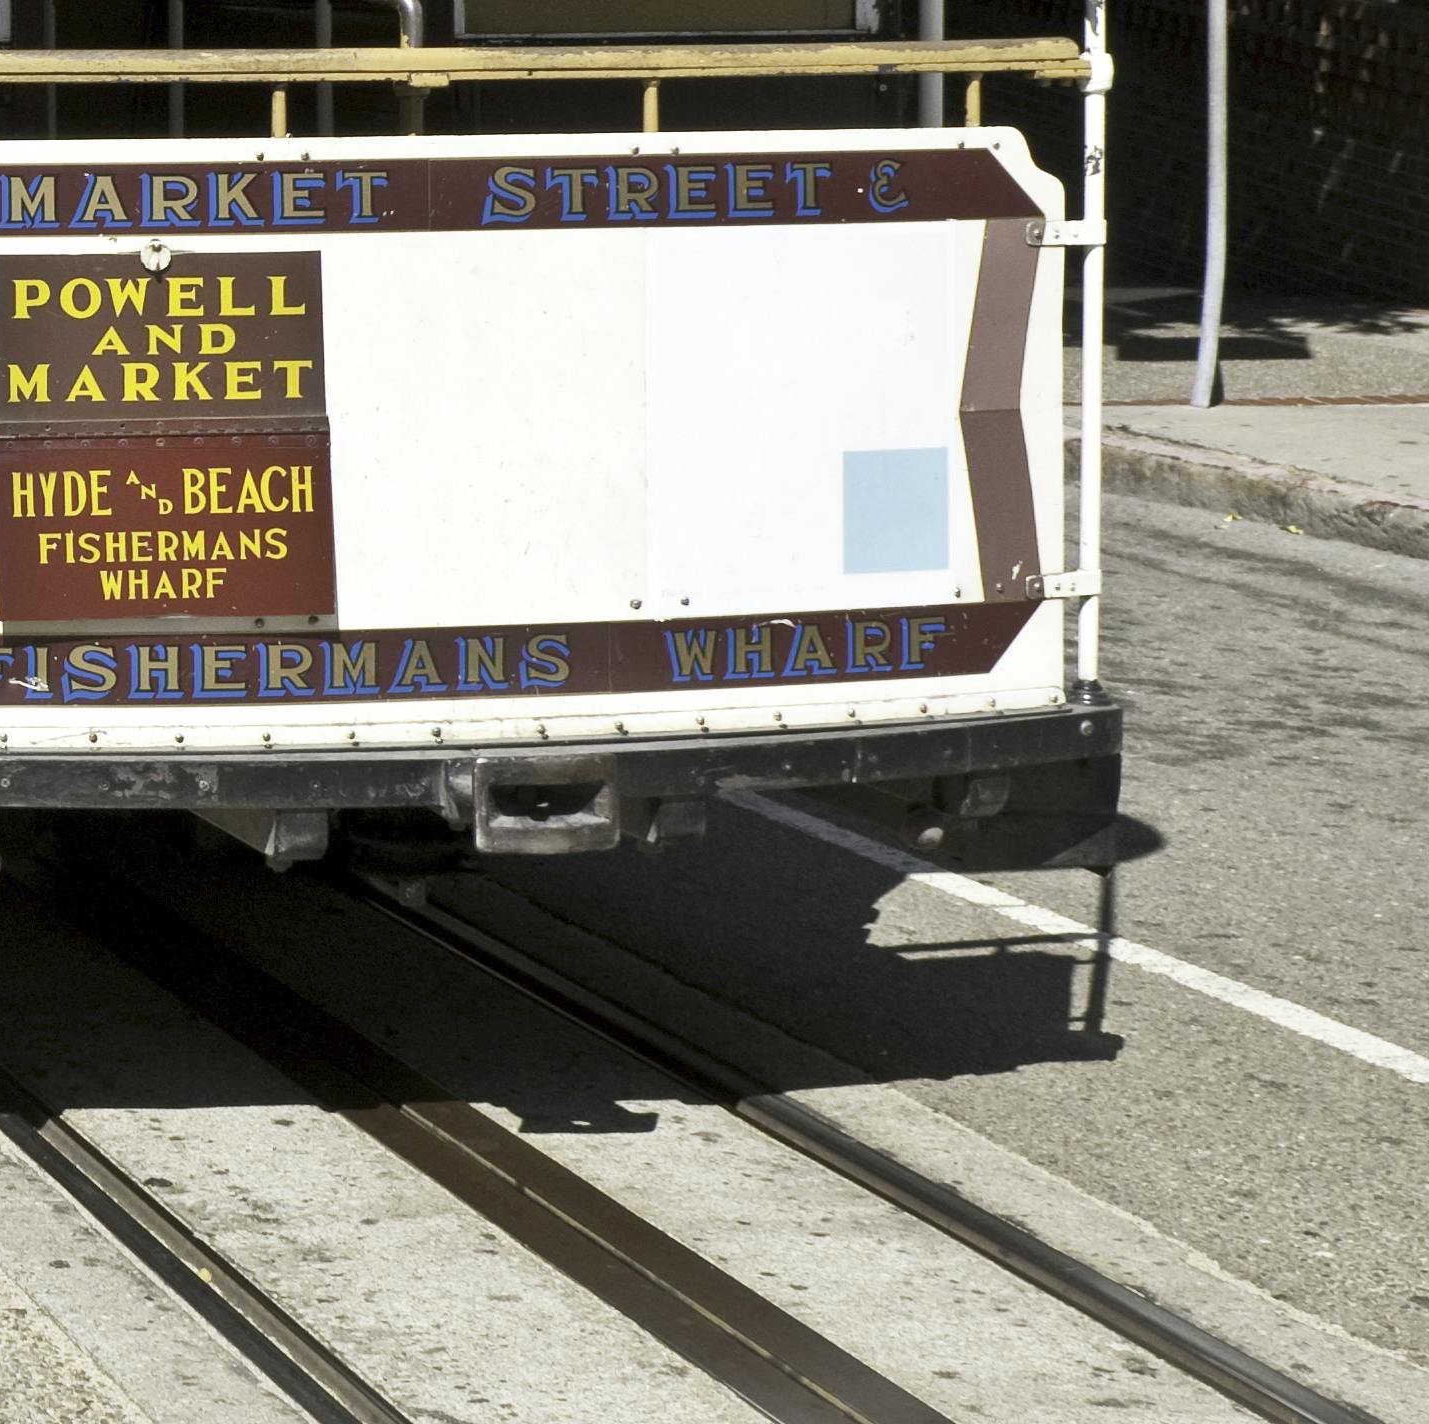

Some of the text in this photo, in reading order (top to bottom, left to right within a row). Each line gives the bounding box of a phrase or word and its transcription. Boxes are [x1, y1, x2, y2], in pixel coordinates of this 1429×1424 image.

[482, 161, 833, 226] STREET
[11, 275, 306, 319] POWELL
[91, 323, 236, 356] AND
[7, 360, 313, 403] MARKET
[11, 465, 315, 518] HYDE AND BEACH
[38, 528, 288, 564] FISHERMANS
[99, 568, 227, 601] WHARF
[662, 616, 946, 682] WHARF
